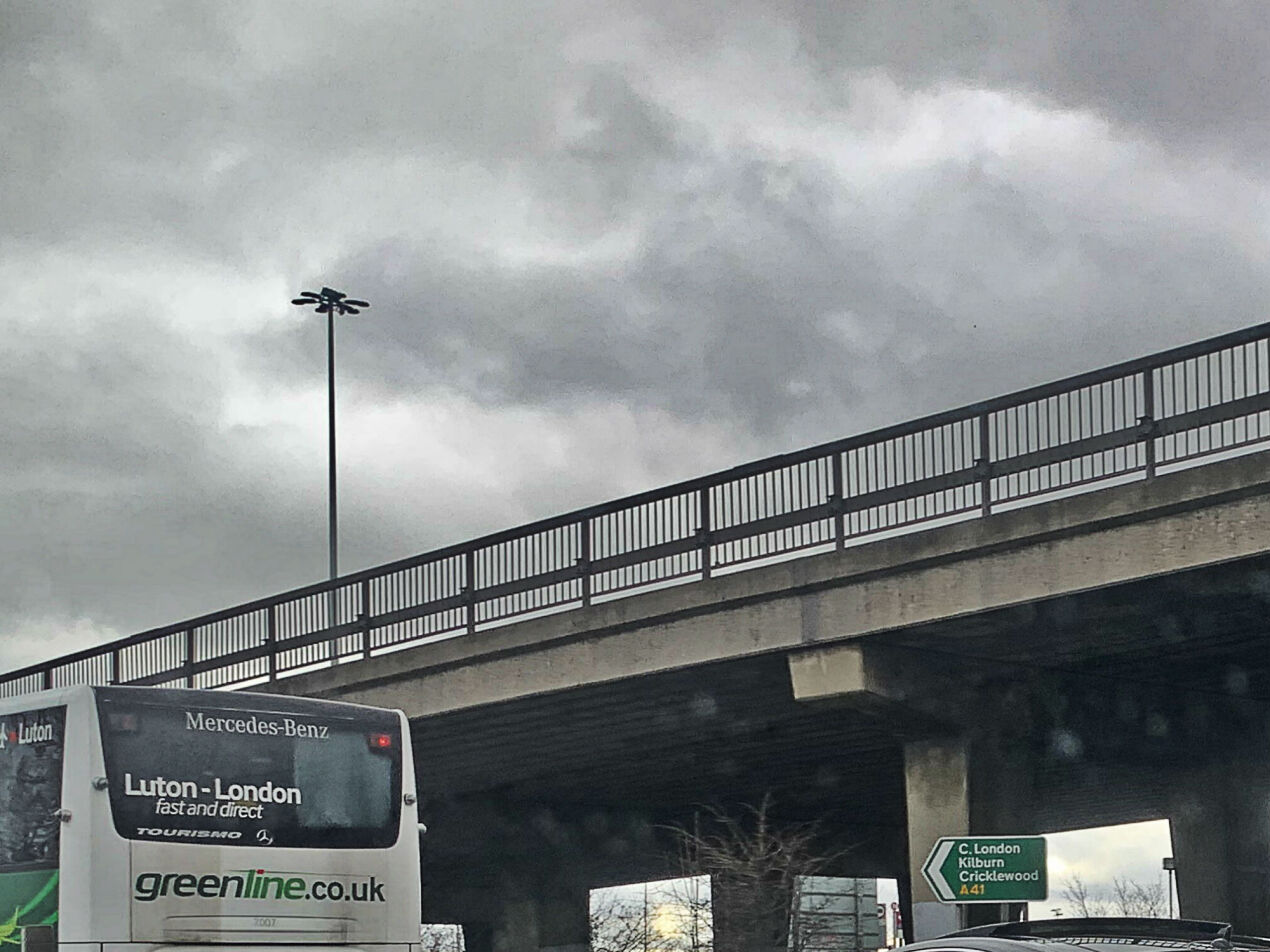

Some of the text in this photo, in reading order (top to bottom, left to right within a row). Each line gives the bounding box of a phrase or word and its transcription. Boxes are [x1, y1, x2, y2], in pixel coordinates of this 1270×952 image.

[18, 722, 52, 744] Luton
[185, 711, 329, 739] Mercedes-Benz
[125, 773, 197, 798] Luton
[215, 778, 302, 804] London
[155, 798, 263, 819] fast and direct
[137, 827, 242, 839] TOURISMO
[958, 843, 1020, 854] C. London
[958, 857, 1004, 868] Kilburn
[959, 870, 1039, 882] Cricklewood
[134, 869, 386, 902] greenline.co.uk
[960, 884, 985, 895] A41
